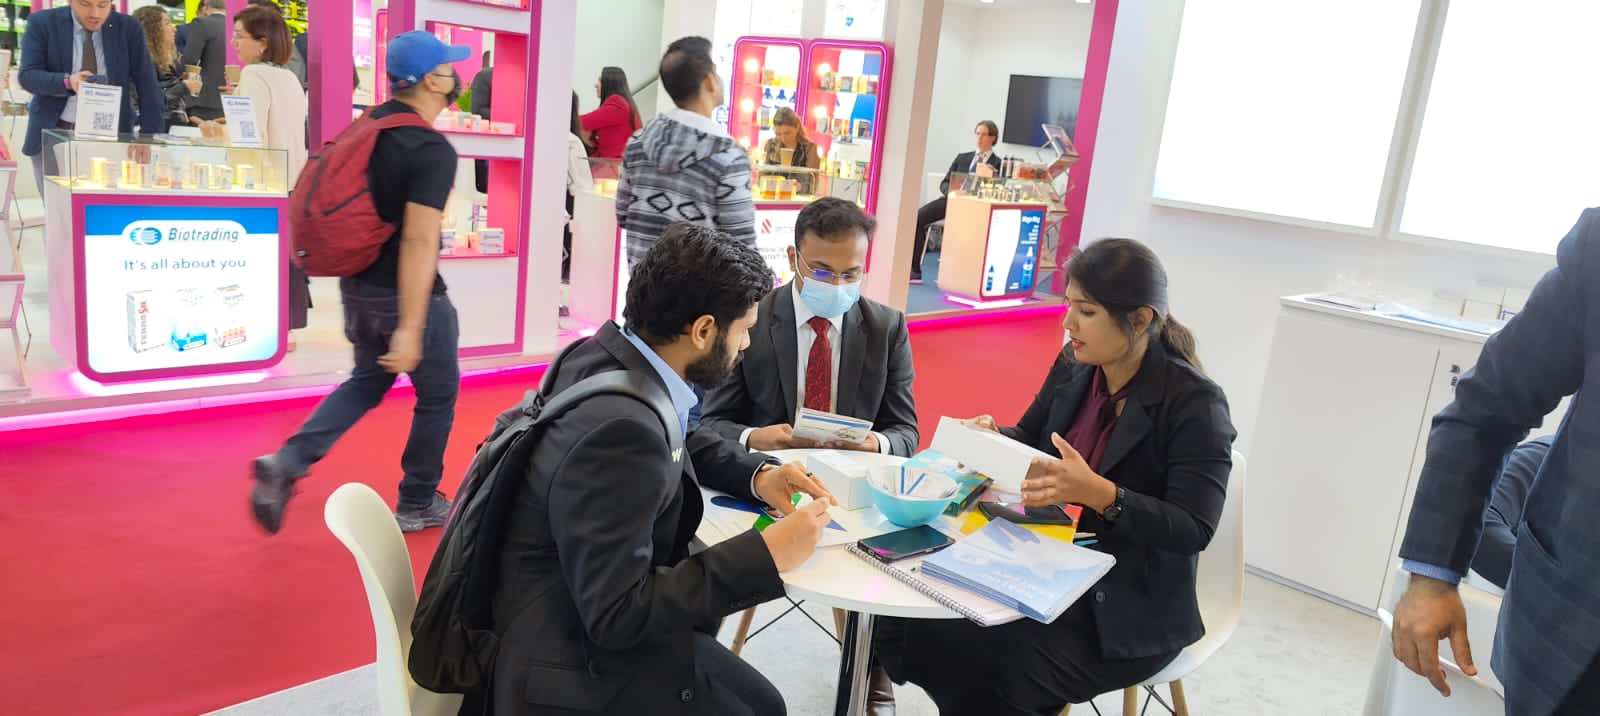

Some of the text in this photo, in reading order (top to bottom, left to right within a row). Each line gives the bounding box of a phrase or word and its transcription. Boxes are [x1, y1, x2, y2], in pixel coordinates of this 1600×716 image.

[168, 227, 239, 243] Biotrading
[124, 257, 246, 270] It's all about you
